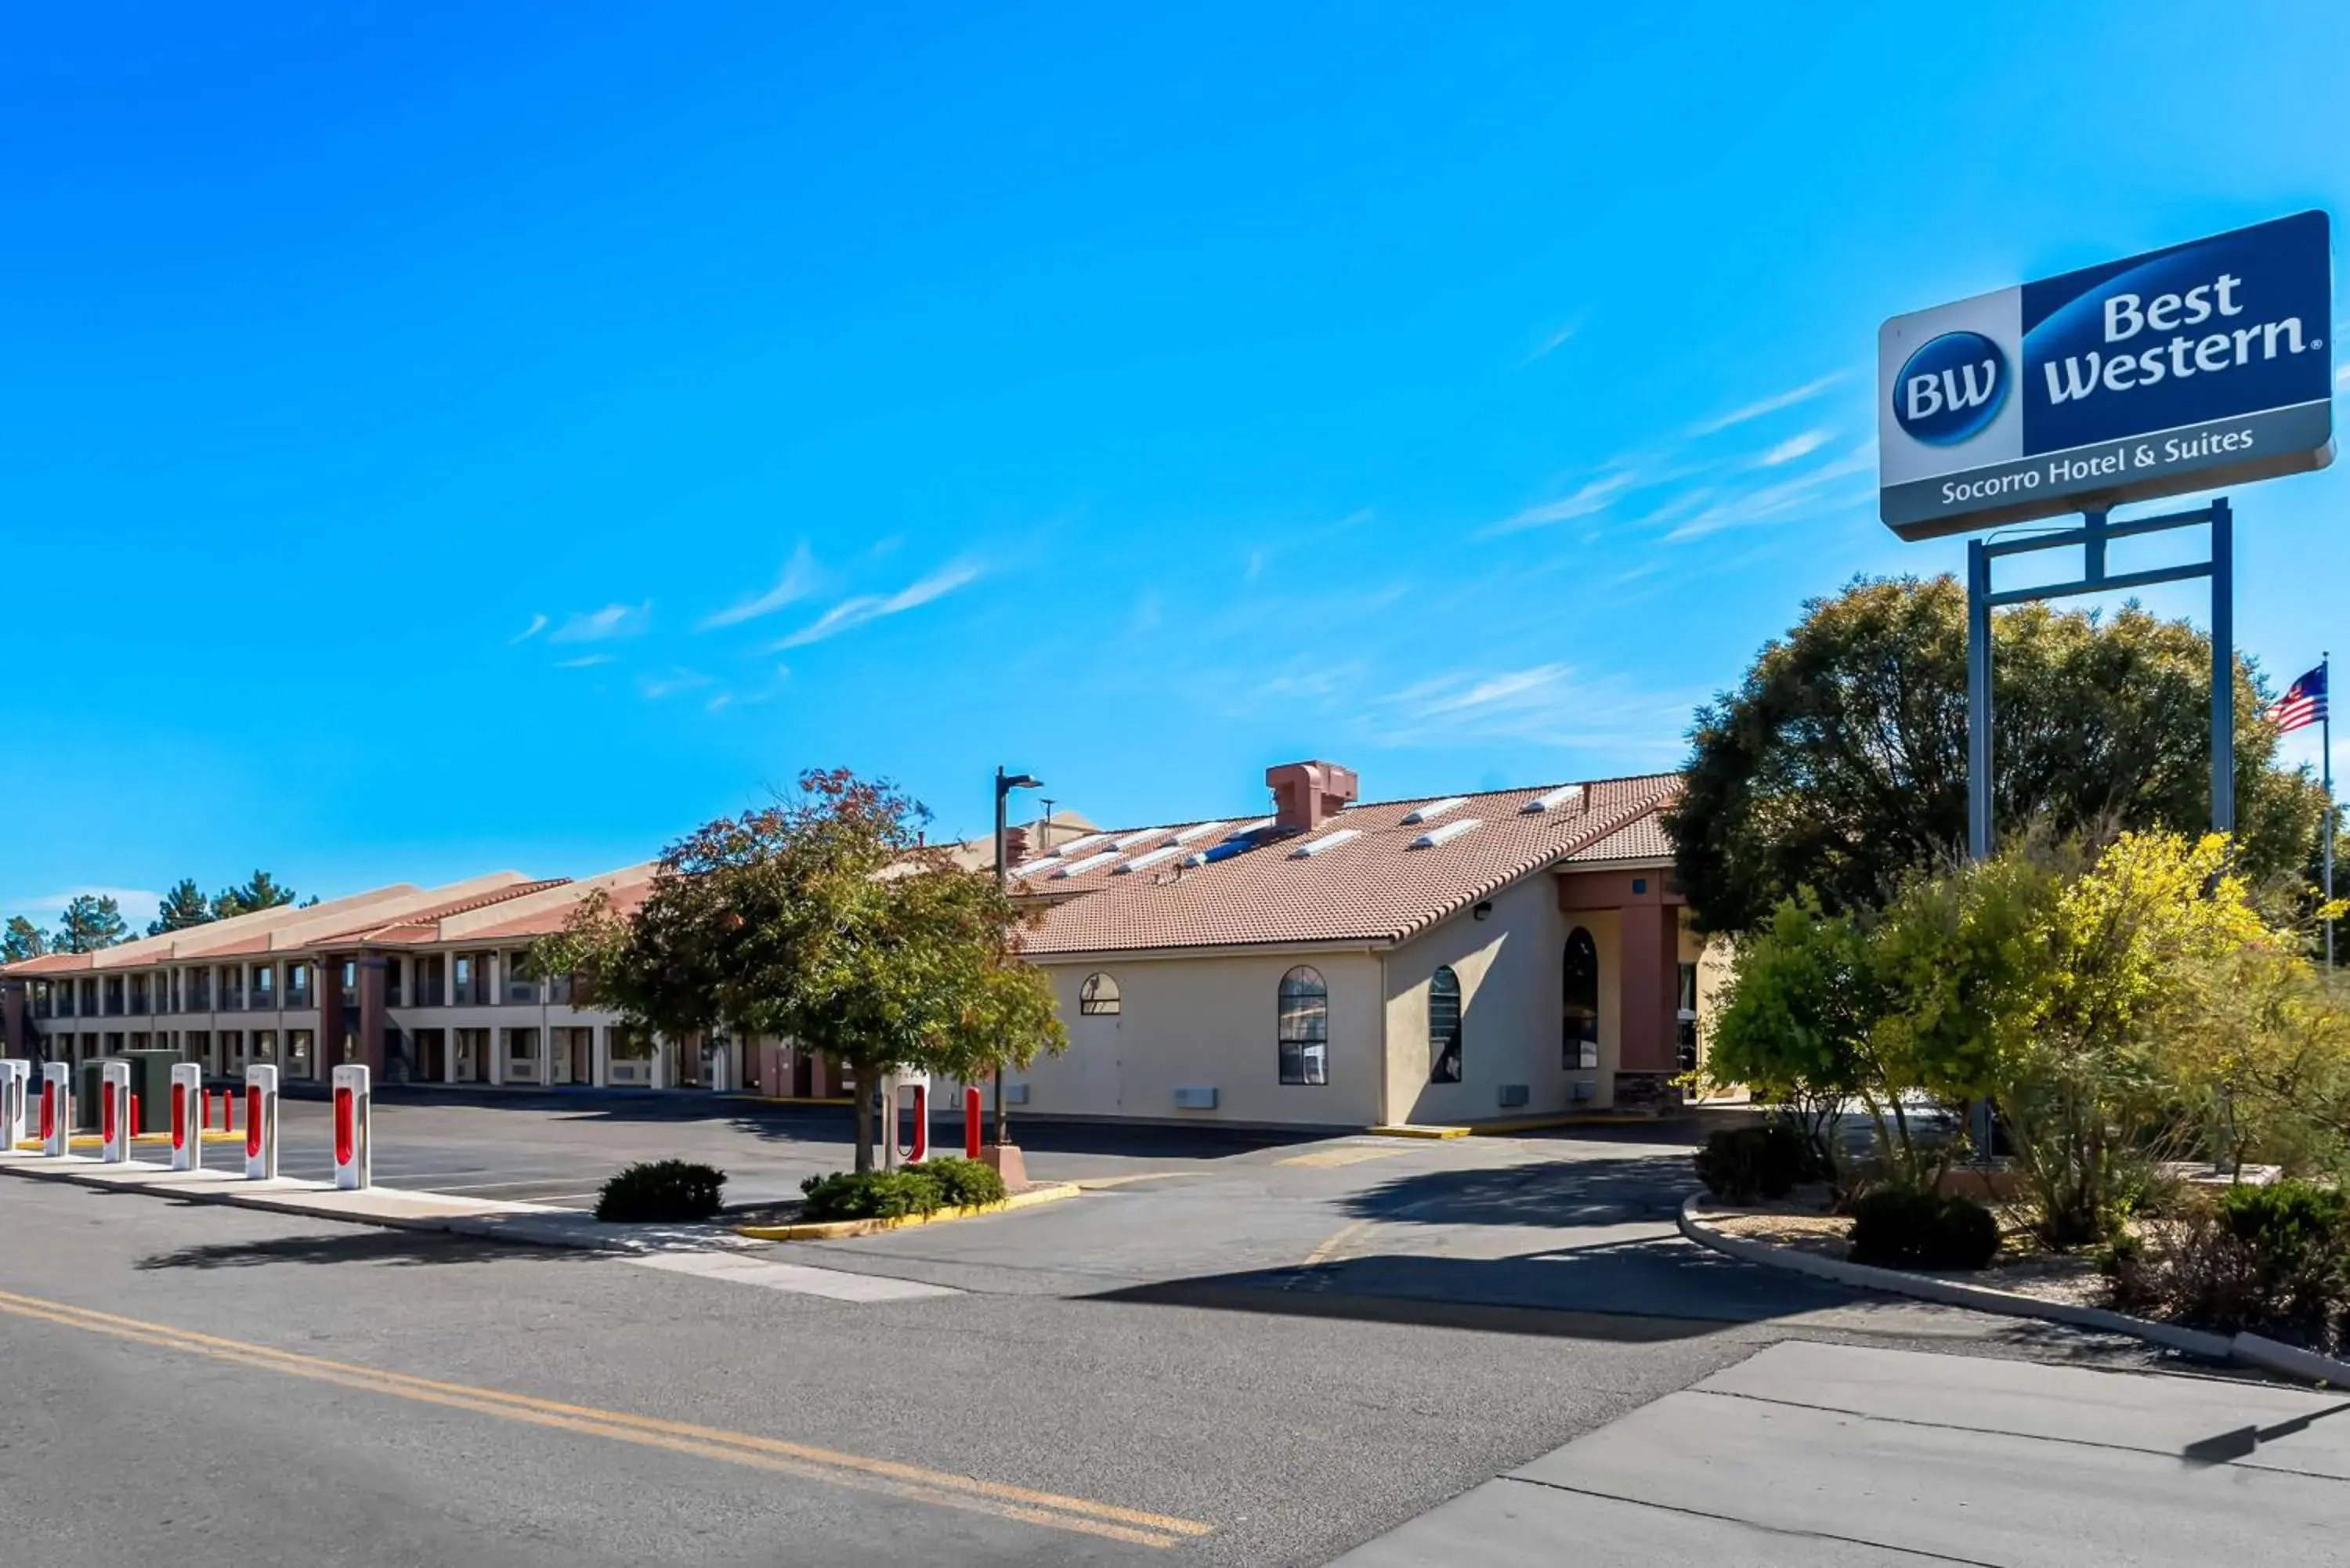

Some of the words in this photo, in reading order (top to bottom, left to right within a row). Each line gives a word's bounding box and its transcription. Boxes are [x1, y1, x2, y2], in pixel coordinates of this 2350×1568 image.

[2105, 274, 2243, 342] Best
[1907, 359, 1995, 420] BW
[1941, 471, 2040, 504] Socorro
[2049, 449, 2125, 483] Hotel
[2135, 444, 2156, 467] &
[2164, 429, 2254, 462] Suites
